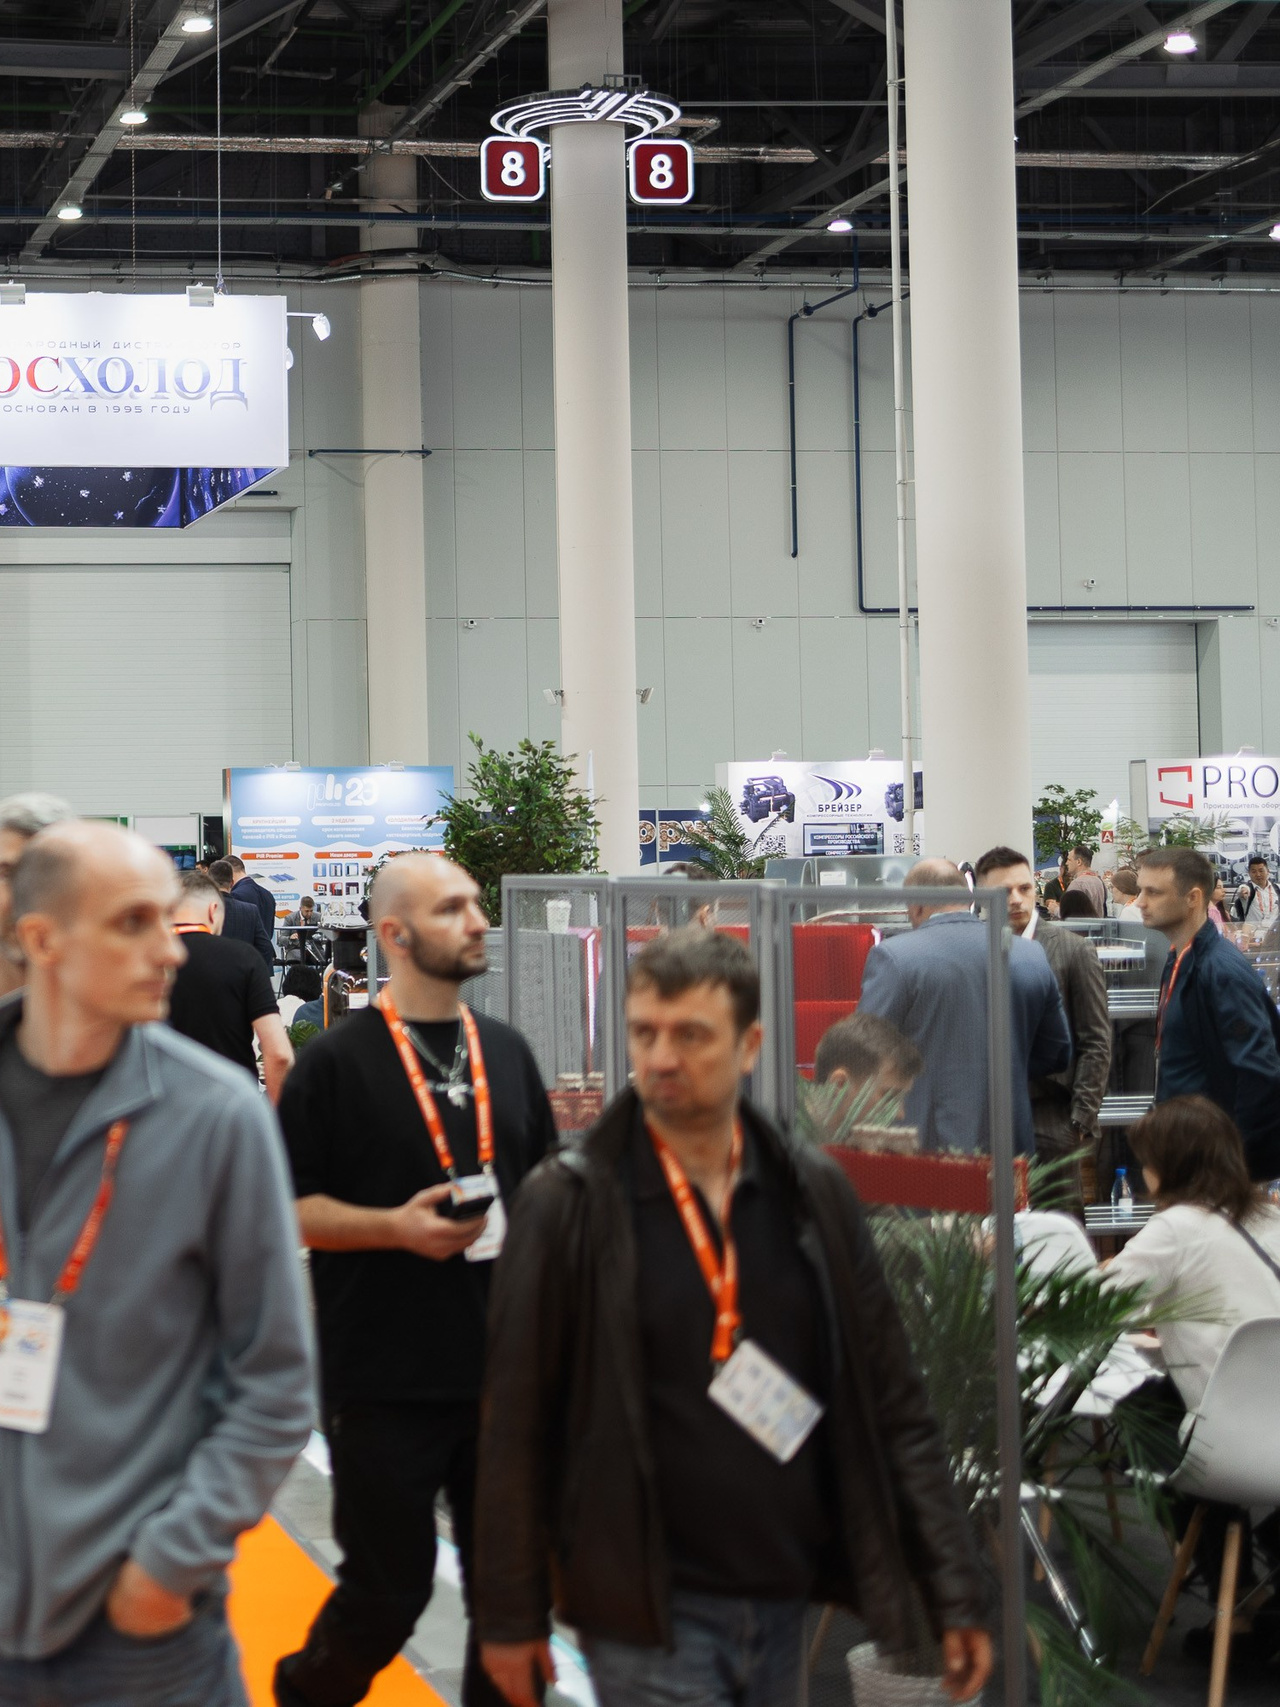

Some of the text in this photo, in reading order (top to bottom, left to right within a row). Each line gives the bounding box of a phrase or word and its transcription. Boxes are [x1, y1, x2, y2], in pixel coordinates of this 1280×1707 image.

[500, 150, 527, 187] 8
[649, 153, 675, 190] 8
[2, 404, 191, 414] ОСНОВАН В 1995 ГОДУ
[817, 803, 862, 813] БРЕЙЗЕР
[1203, 802, 1260, 810] Производитель
